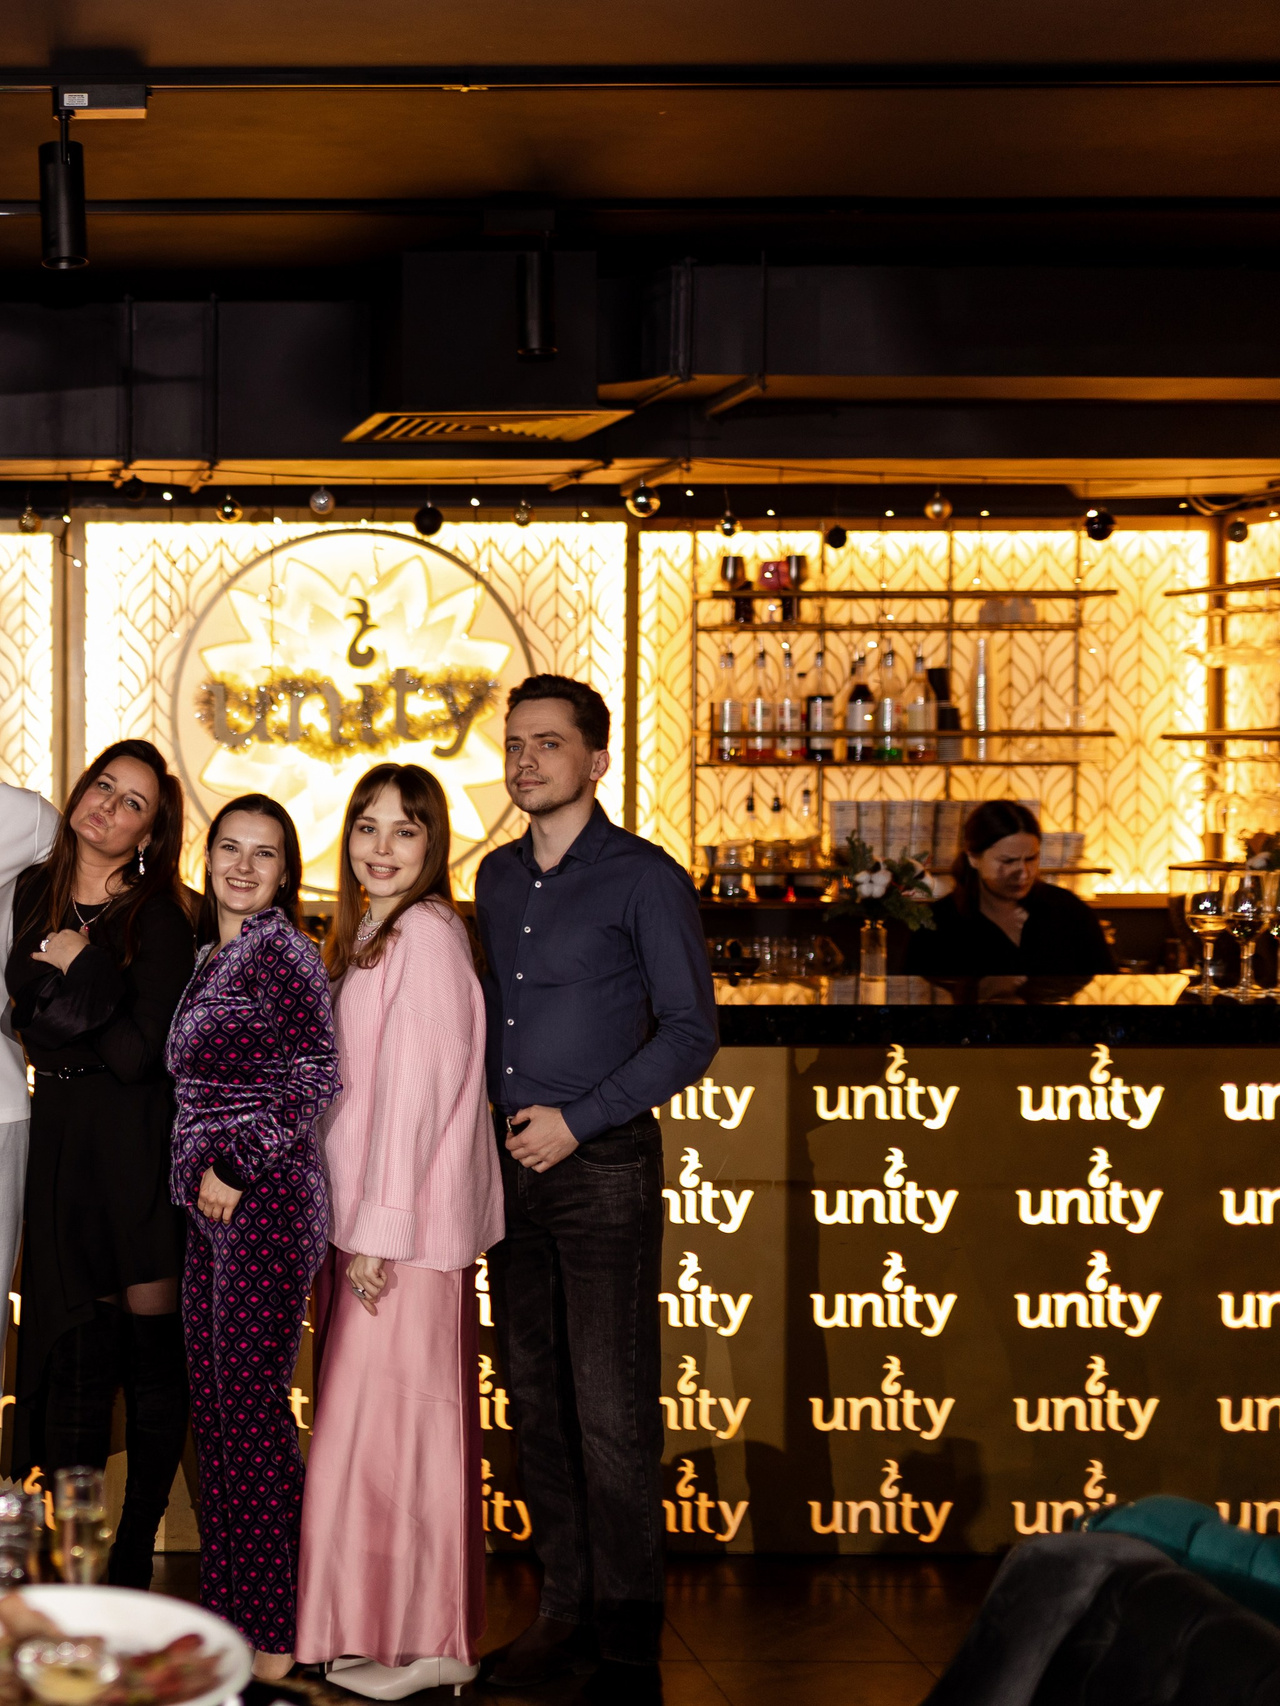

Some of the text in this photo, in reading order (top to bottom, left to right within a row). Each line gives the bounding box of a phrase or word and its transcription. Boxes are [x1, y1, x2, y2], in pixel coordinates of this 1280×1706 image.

[209, 598, 499, 759] unity
[651, 1077, 756, 1130] ity
[812, 1043, 960, 1130] unity
[1016, 1043, 1165, 1130] unity
[661, 1147, 755, 1234] nity
[810, 1147, 960, 1234] unity
[1015, 1146, 1164, 1234] unity
[658, 1251, 753, 1337] nity
[809, 1251, 958, 1338] unity
[1013, 1249, 1163, 1338] unity
[659, 1355, 751, 1440] nity
[808, 1355, 956, 1441] unity
[1013, 1355, 1160, 1441] unity
[808, 1459, 953, 1543] unity
